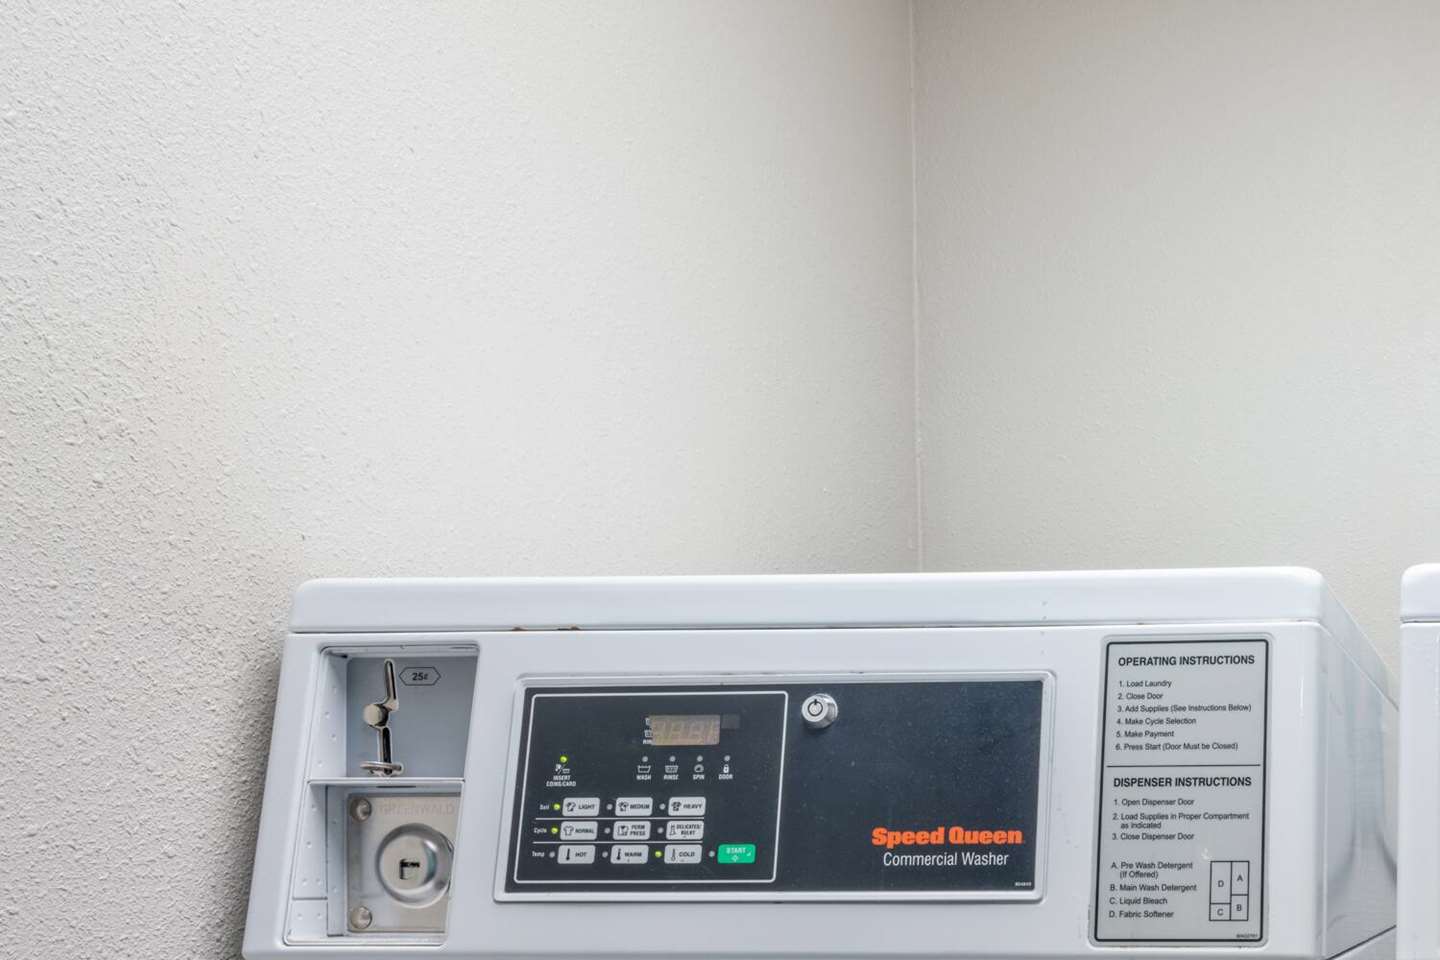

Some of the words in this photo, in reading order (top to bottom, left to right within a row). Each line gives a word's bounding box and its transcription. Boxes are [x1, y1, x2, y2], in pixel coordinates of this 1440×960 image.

[1118, 656, 1177, 666] OPERATING
[1179, 655, 1255, 665] INSTRUCTIONS
[1126, 680, 1143, 688] Load
[1145, 680, 1172, 688] Laundry
[1140, 705, 1169, 713] Supplies
[1170, 704, 1187, 713] (See
[1228, 704, 1251, 712] Below)
[1145, 718, 1164, 726] Cycle
[1124, 730, 1143, 738] Make
[1145, 730, 1174, 739] Payment
[1124, 743, 1143, 751] Press
[1145, 743, 1161, 751] Start
[1162, 743, 1182, 751] (Door
[1211, 743, 1238, 751] Closed)
[1114, 777, 1172, 787] DISPENSER
[1175, 777, 1251, 787] INSTRUCTIONS
[1121, 799, 1140, 807] Open
[1142, 798, 1176, 807] Dispenser
[1140, 813, 1169, 821] Supplies
[1178, 813, 1201, 821] Proper
[1203, 813, 1249, 821] Compartment
[872, 826, 944, 849] Speed
[949, 826, 1023, 845] Queen
[1142, 833, 1176, 841] Dispenser
[532, 851, 545, 859] Temp
[883, 852, 957, 866] Commercial
[962, 852, 1009, 866] Washer
[1157, 862, 1193, 870] Detergent
[1129, 871, 1158, 879] Offered)
[1161, 884, 1197, 892] Detergent
[1119, 897, 1141, 905] Liquid
